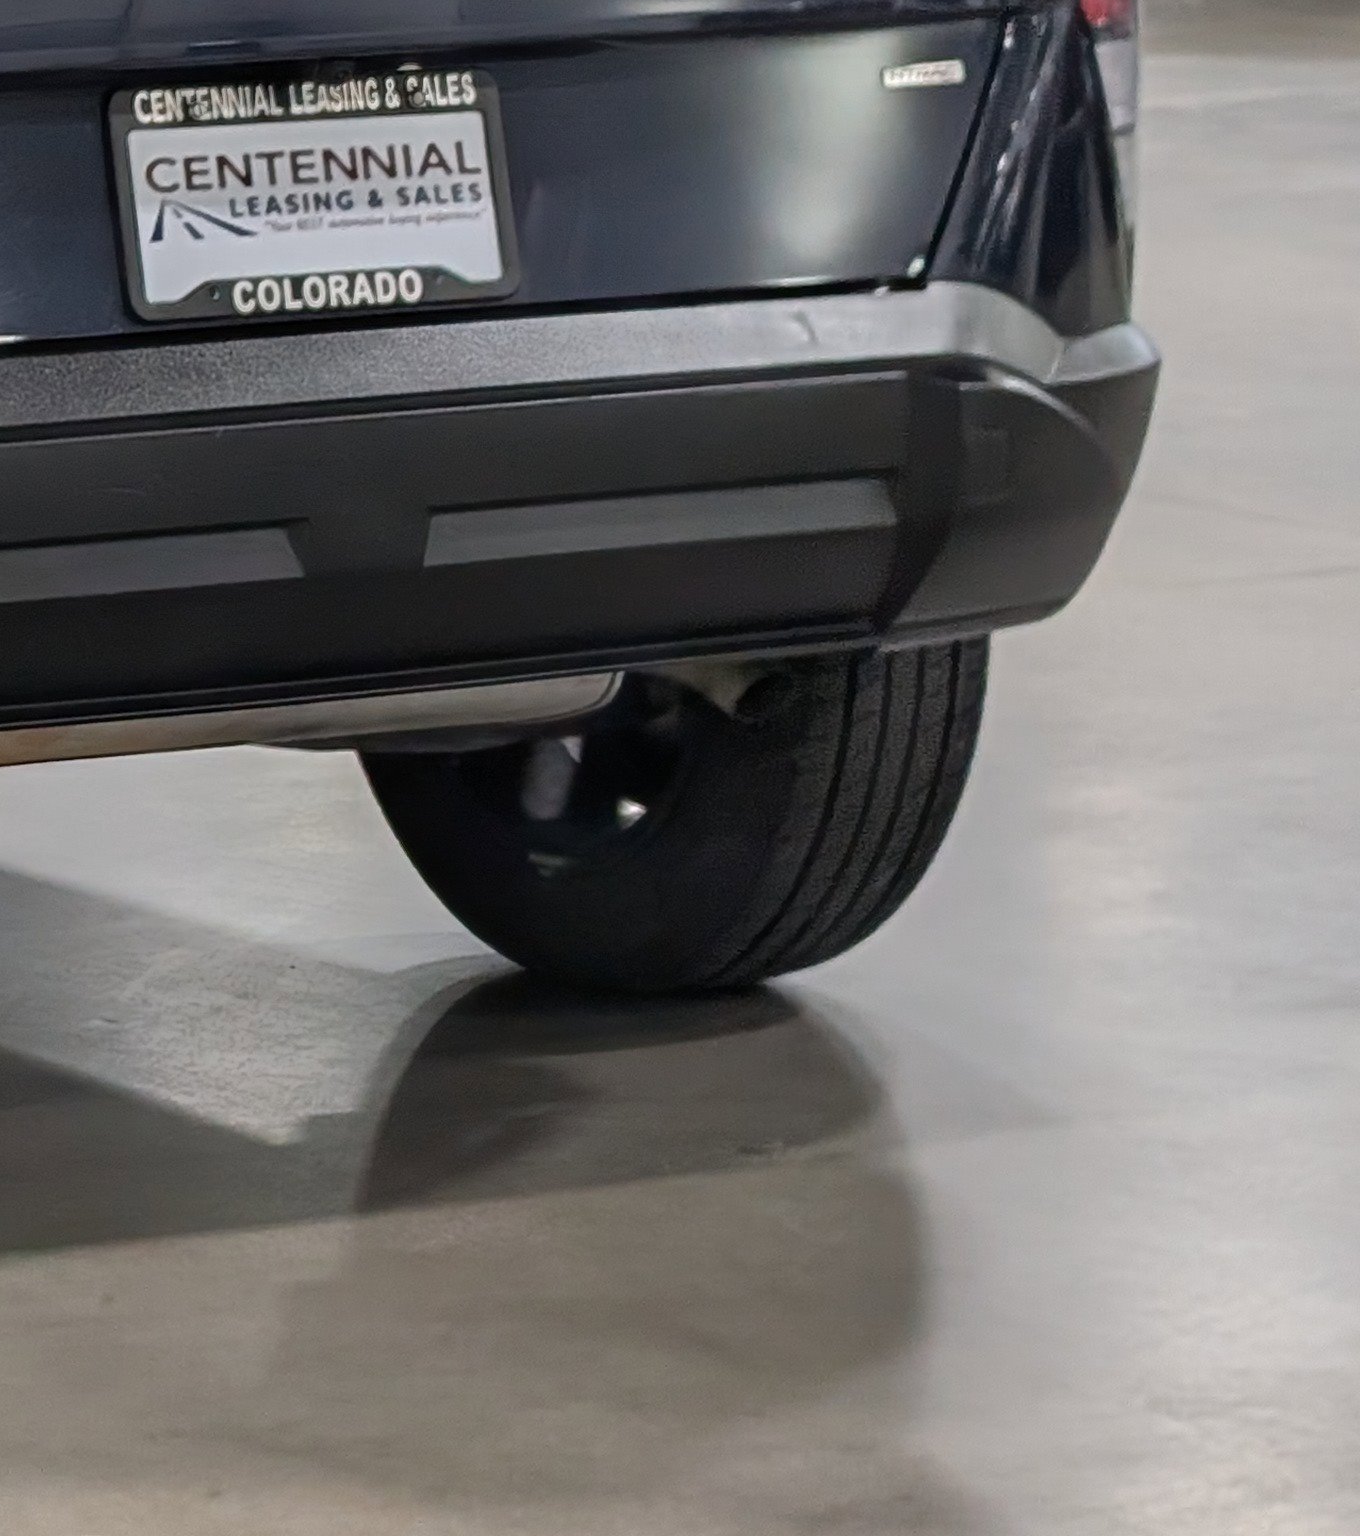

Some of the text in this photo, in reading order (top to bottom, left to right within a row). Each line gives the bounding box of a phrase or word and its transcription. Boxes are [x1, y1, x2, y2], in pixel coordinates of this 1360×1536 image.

[133, 71, 477, 124] CENTENNIAL LEASING & SALES
[145, 141, 482, 194] CENTENNIAL
[229, 182, 483, 217] LEASING & SALES
[233, 268, 424, 314] COLORADO
